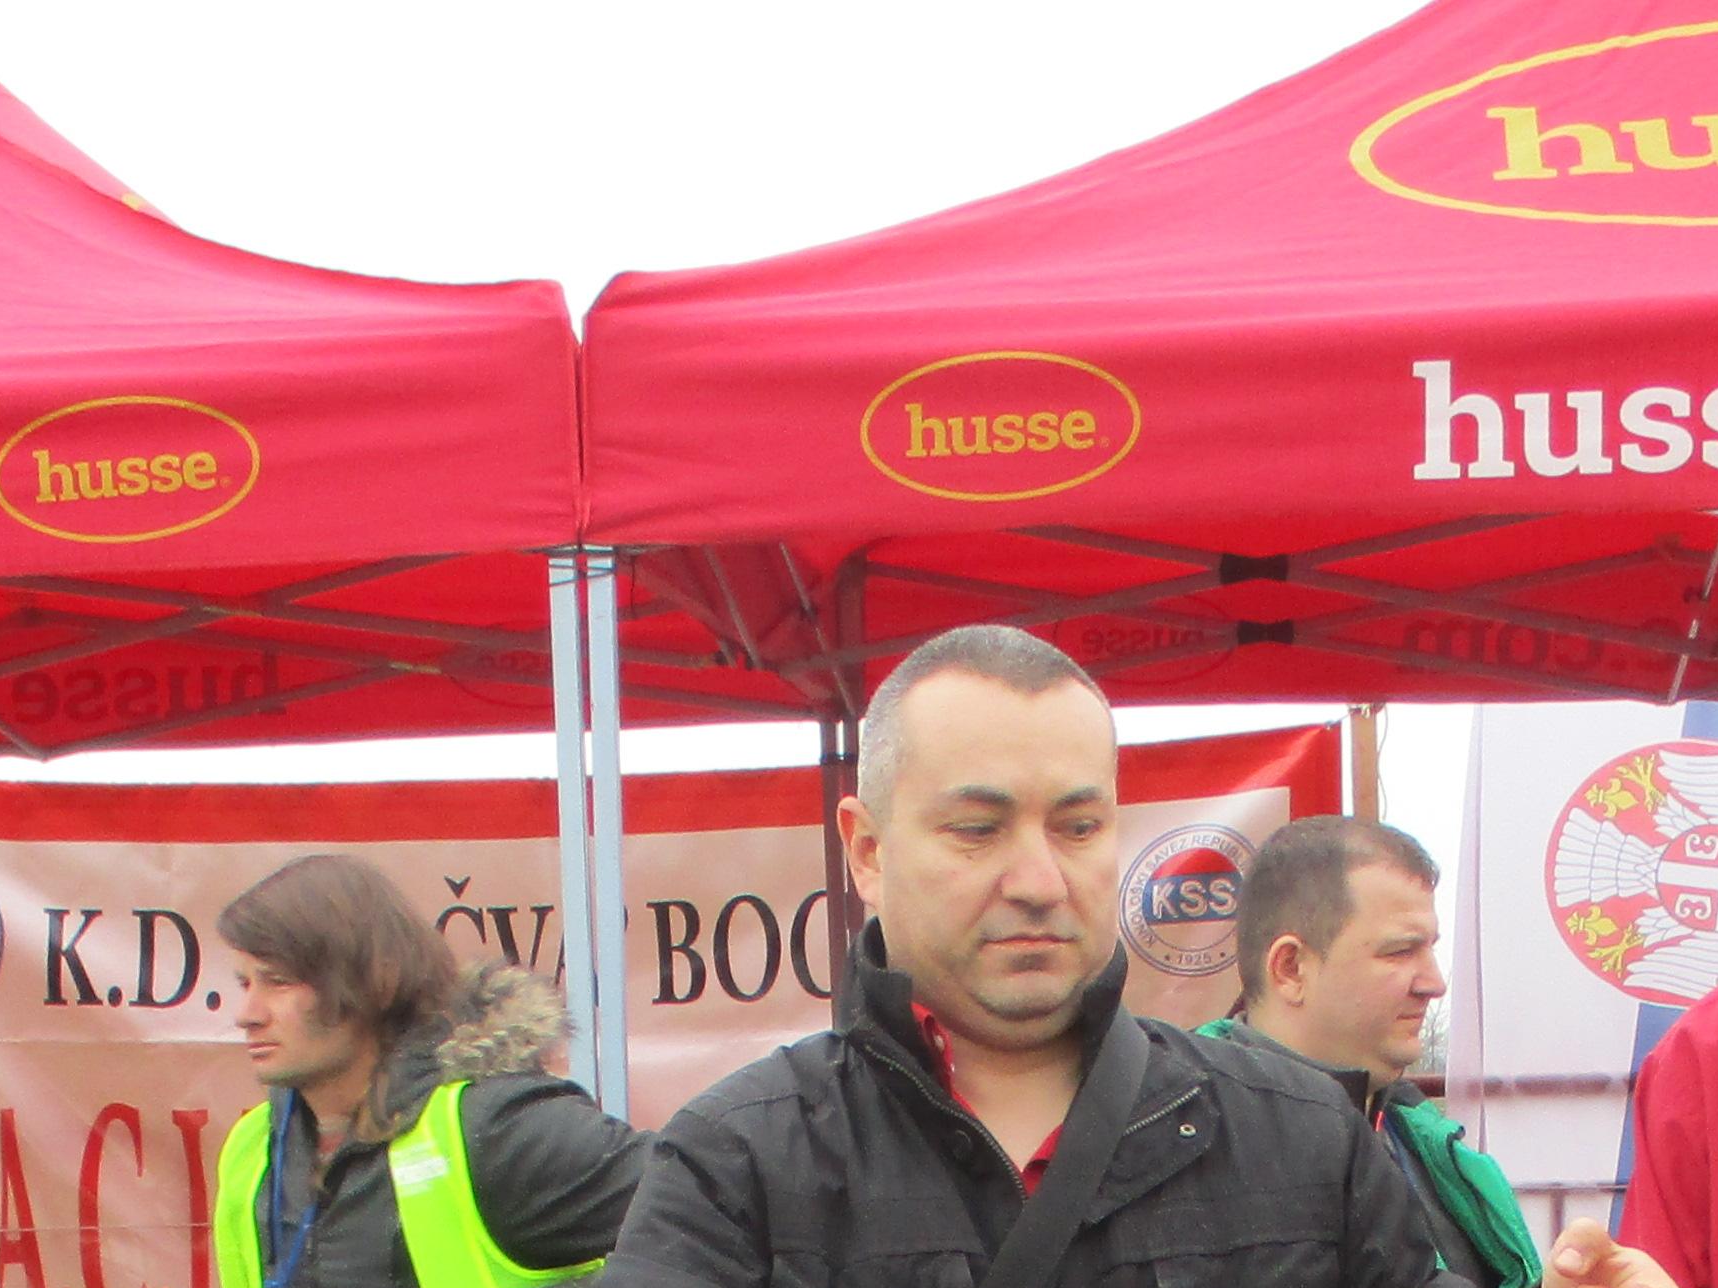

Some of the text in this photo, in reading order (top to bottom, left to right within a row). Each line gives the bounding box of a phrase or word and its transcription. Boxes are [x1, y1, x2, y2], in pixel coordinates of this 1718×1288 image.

[905, 400, 1096, 458] husse
[31, 446, 217, 506] husse
[1150, 878, 1238, 920] KSS
[42, 907, 222, 1012] K.D.
